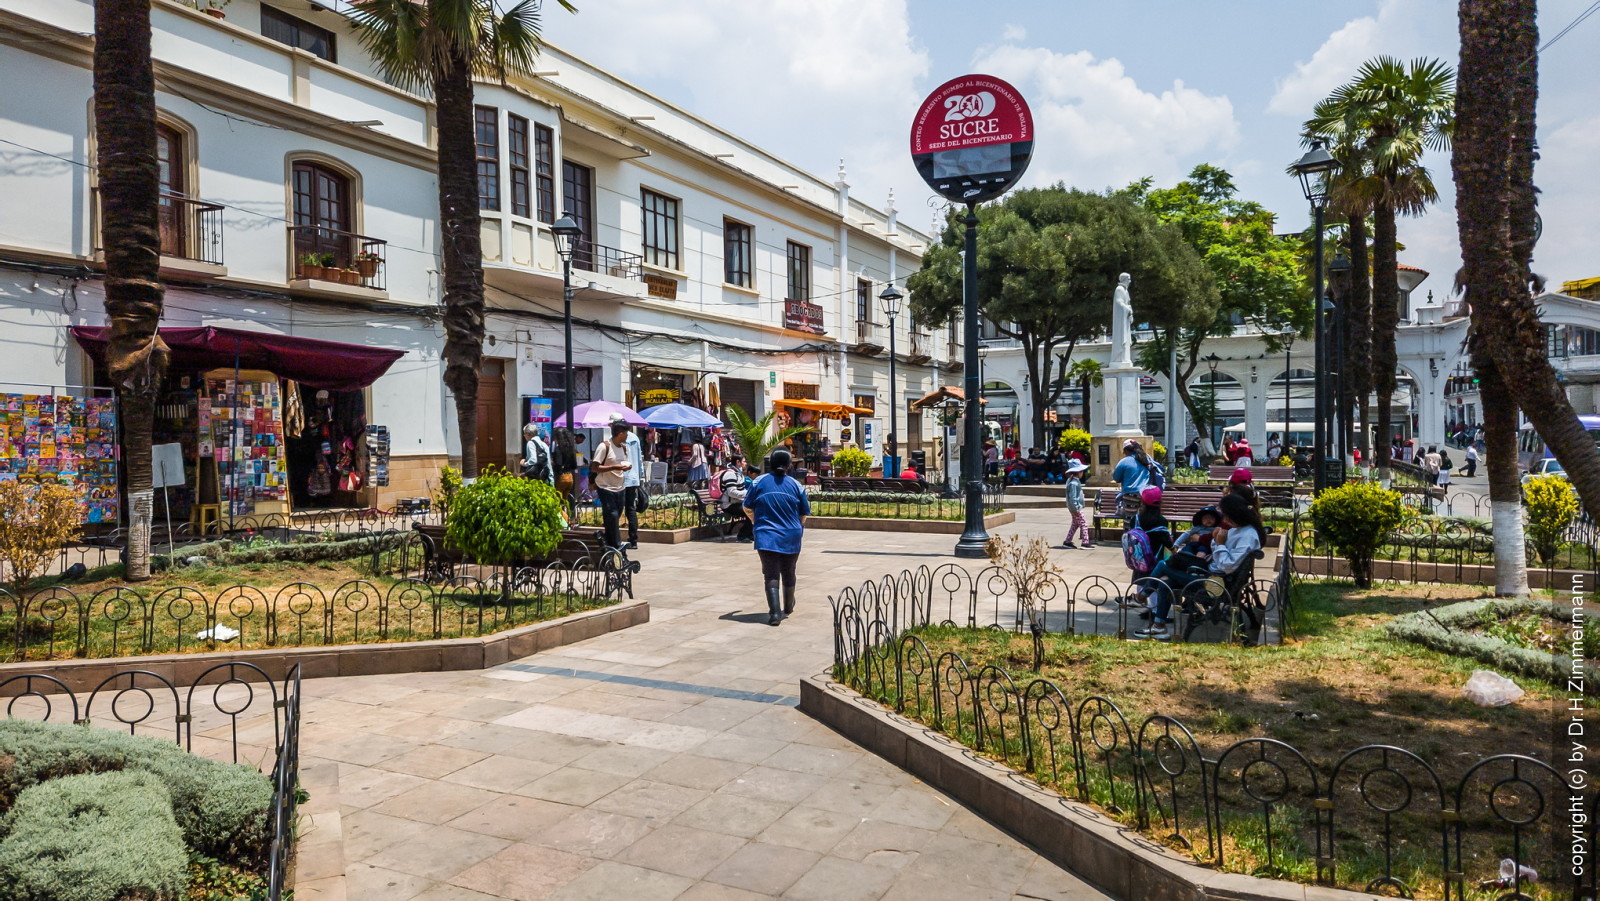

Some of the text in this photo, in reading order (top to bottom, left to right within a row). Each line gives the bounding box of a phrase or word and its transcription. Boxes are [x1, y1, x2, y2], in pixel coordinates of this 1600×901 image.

[920, 94, 942, 125] REGRESIVO
[943, 82, 964, 97] RUMBO
[975, 80, 1016, 104] BICENTENARIO
[1014, 103, 1021, 113] DE
[1018, 112, 1027, 138] BOLIVIA
[940, 118, 999, 139] SUCRE
[962, 133, 1013, 145] BICENTENARIO
[791, 303, 822, 320] ABOGADOS
